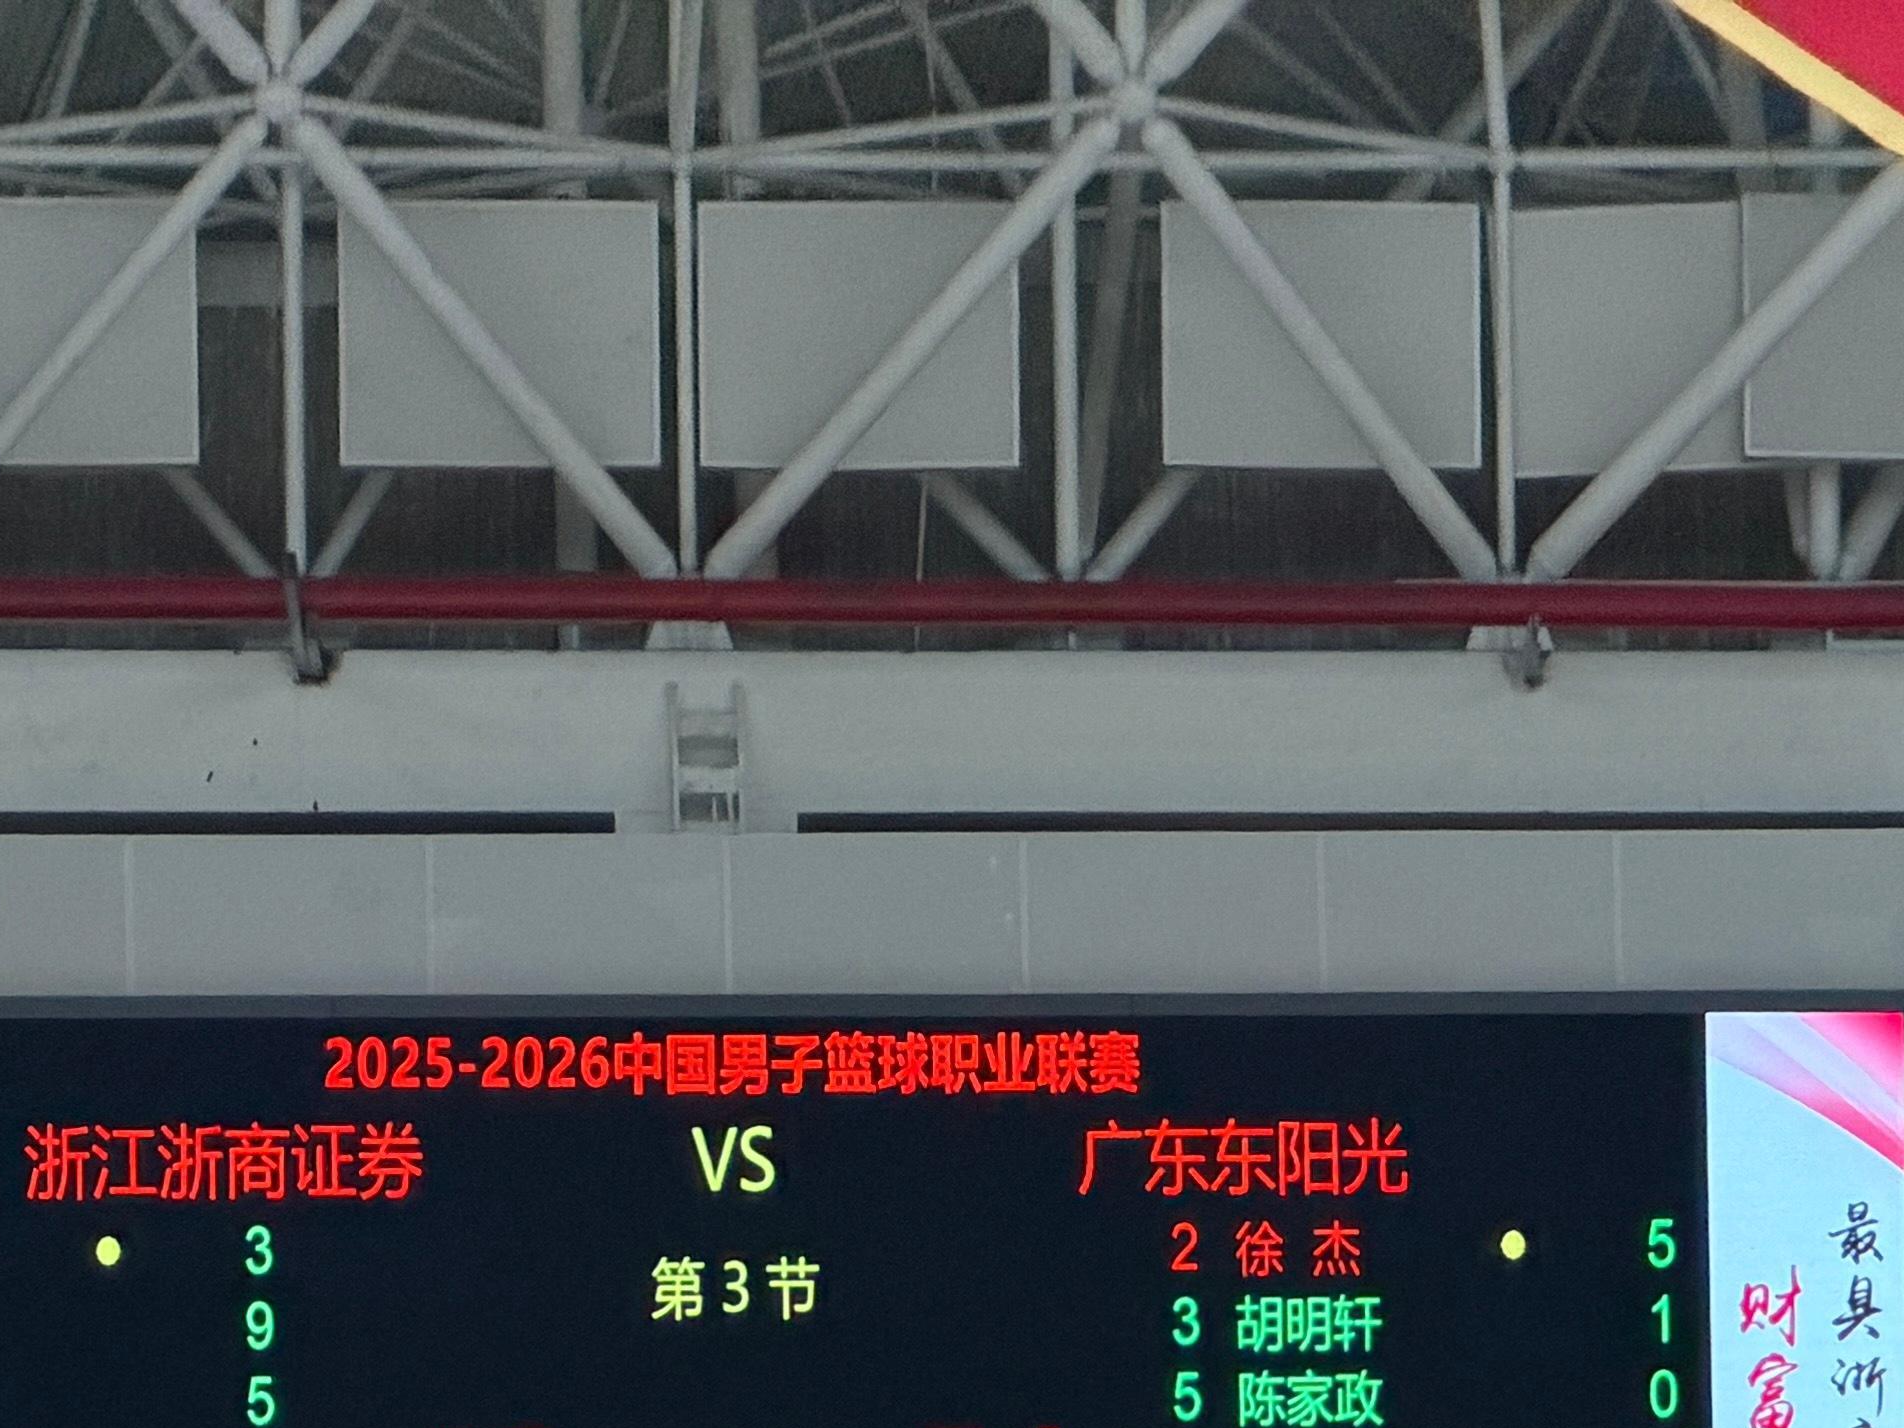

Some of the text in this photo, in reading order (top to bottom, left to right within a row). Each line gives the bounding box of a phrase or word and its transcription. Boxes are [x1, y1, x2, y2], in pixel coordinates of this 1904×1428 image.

[325, 1031, 1140, 1095] 2025-2026中国男子篮球职业联赛
[24, 1122, 423, 1200] 浙江浙商证券
[692, 1126, 775, 1192] VS
[1079, 1117, 1408, 1196] 广东东阳光
[246, 1225, 273, 1275] 3
[1172, 1222, 1198, 1270] 2
[1648, 1219, 1675, 1268] 5
[246, 1301, 274, 1350] 9
[1173, 1294, 1669, 1352] 3 胡明轩 1
[247, 1376, 275, 1426] 5
[1174, 1369, 1678, 1427] 5 陈家政 0
